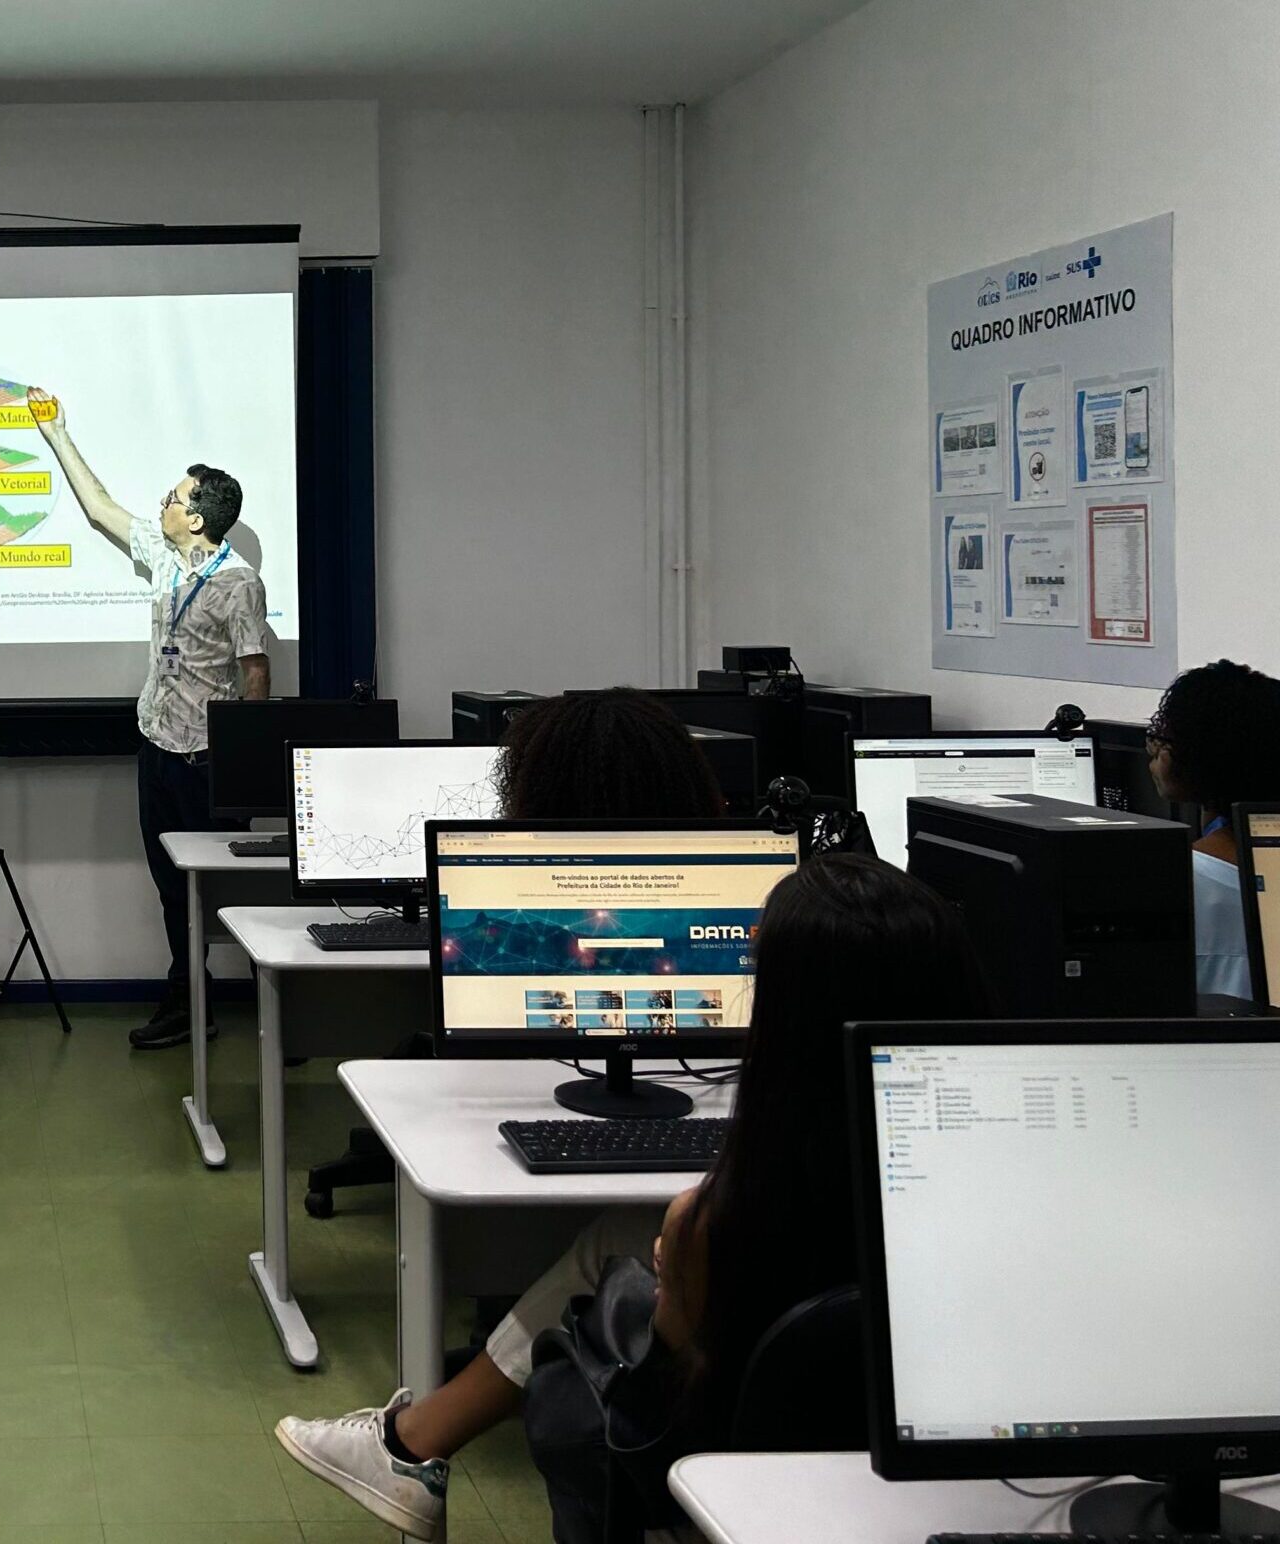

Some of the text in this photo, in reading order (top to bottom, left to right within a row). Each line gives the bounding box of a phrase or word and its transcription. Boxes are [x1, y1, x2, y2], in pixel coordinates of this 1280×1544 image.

[1066, 260, 1082, 275] SUS
[1018, 271, 1037, 289] Rio
[951, 288, 1136, 350] QUADRO INFORMATIVO
[0, 477, 47, 489] Vetorial
[0, 550, 65, 562] Mundo real
[600, 874, 619, 882] portal
[619, 1043, 638, 1051] AOC
[1214, 1446, 1248, 1460] AOC
